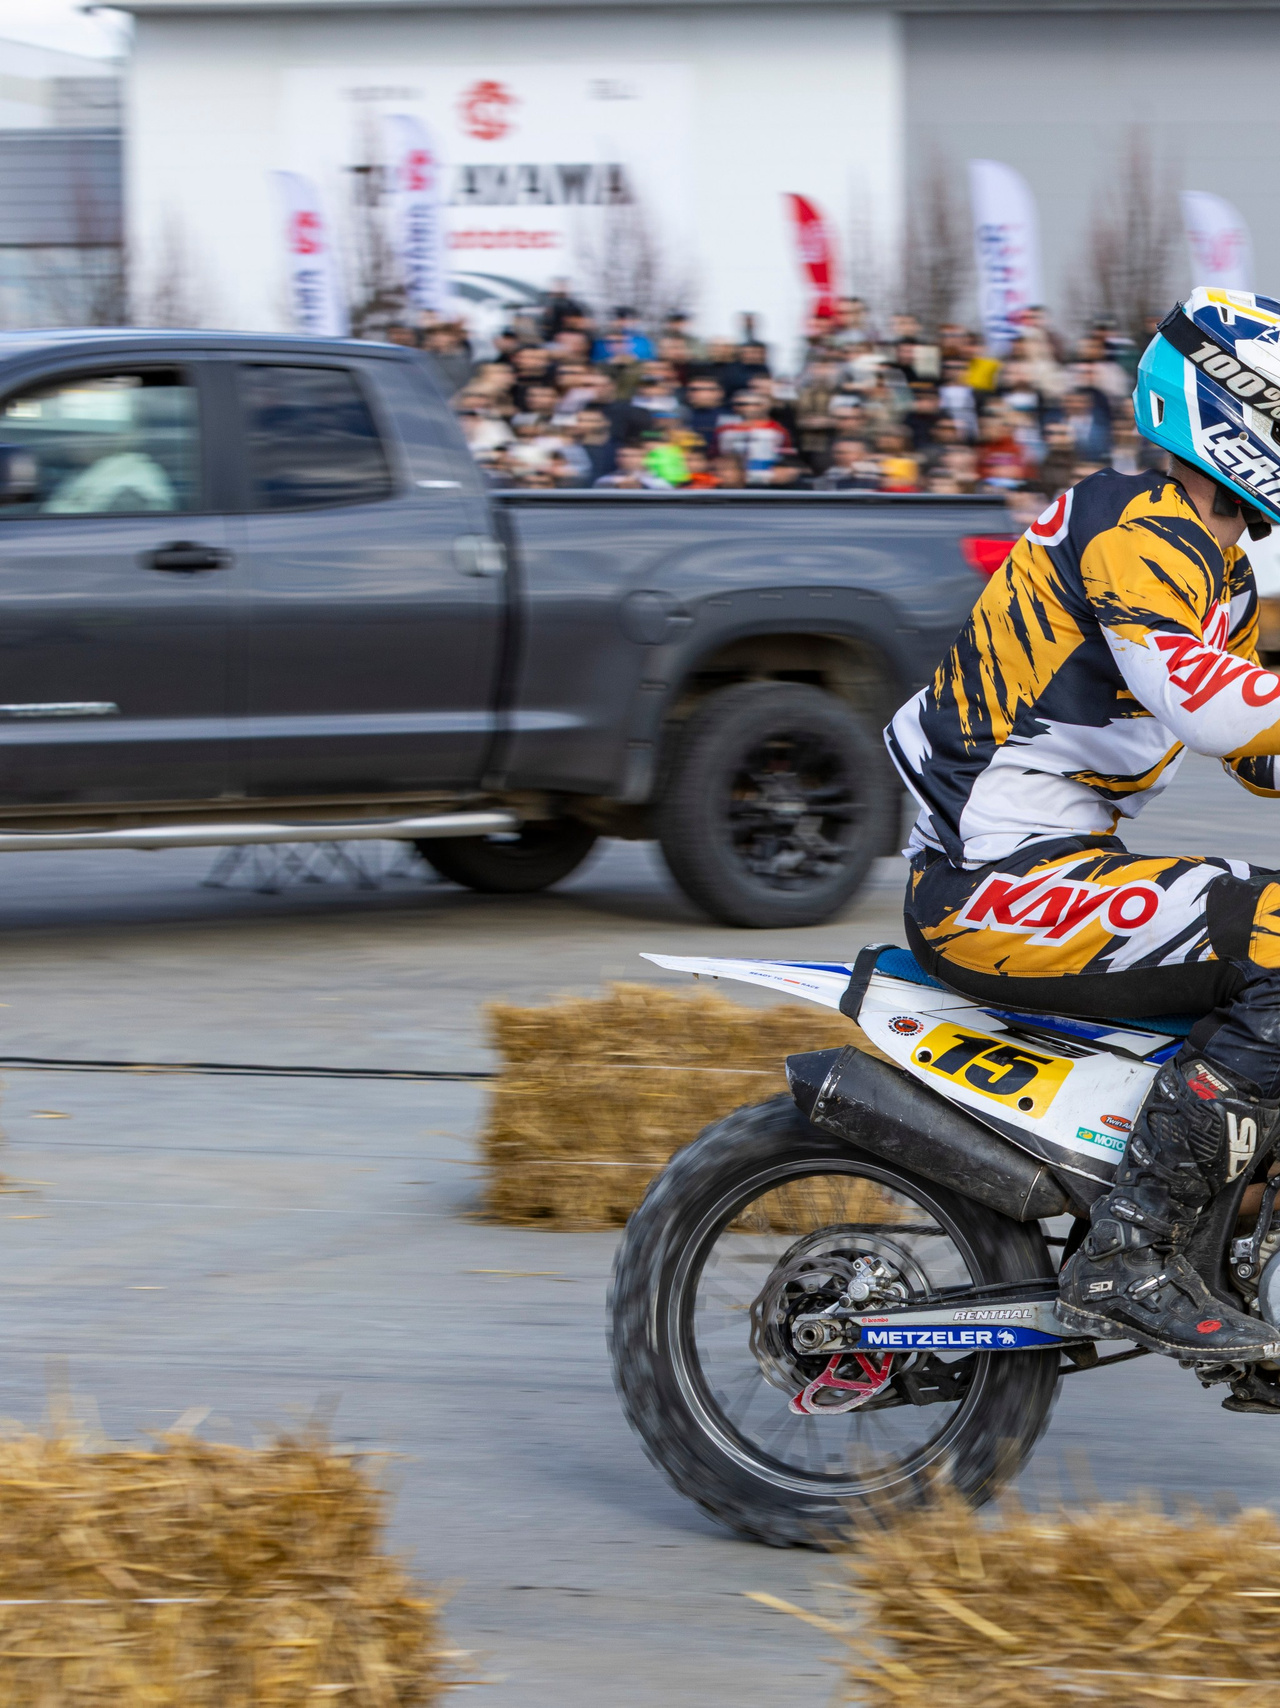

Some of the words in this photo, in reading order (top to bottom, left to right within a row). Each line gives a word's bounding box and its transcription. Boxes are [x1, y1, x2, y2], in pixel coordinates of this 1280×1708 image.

[965, 869, 1159, 939] KAYO
[931, 1034, 1054, 1095] 15
[1105, 1116, 1123, 1128] Twin
[1094, 1135, 1127, 1151] MOTO
[953, 1309, 1032, 1321] RENTHAL
[867, 1331, 993, 1345] METZELER
